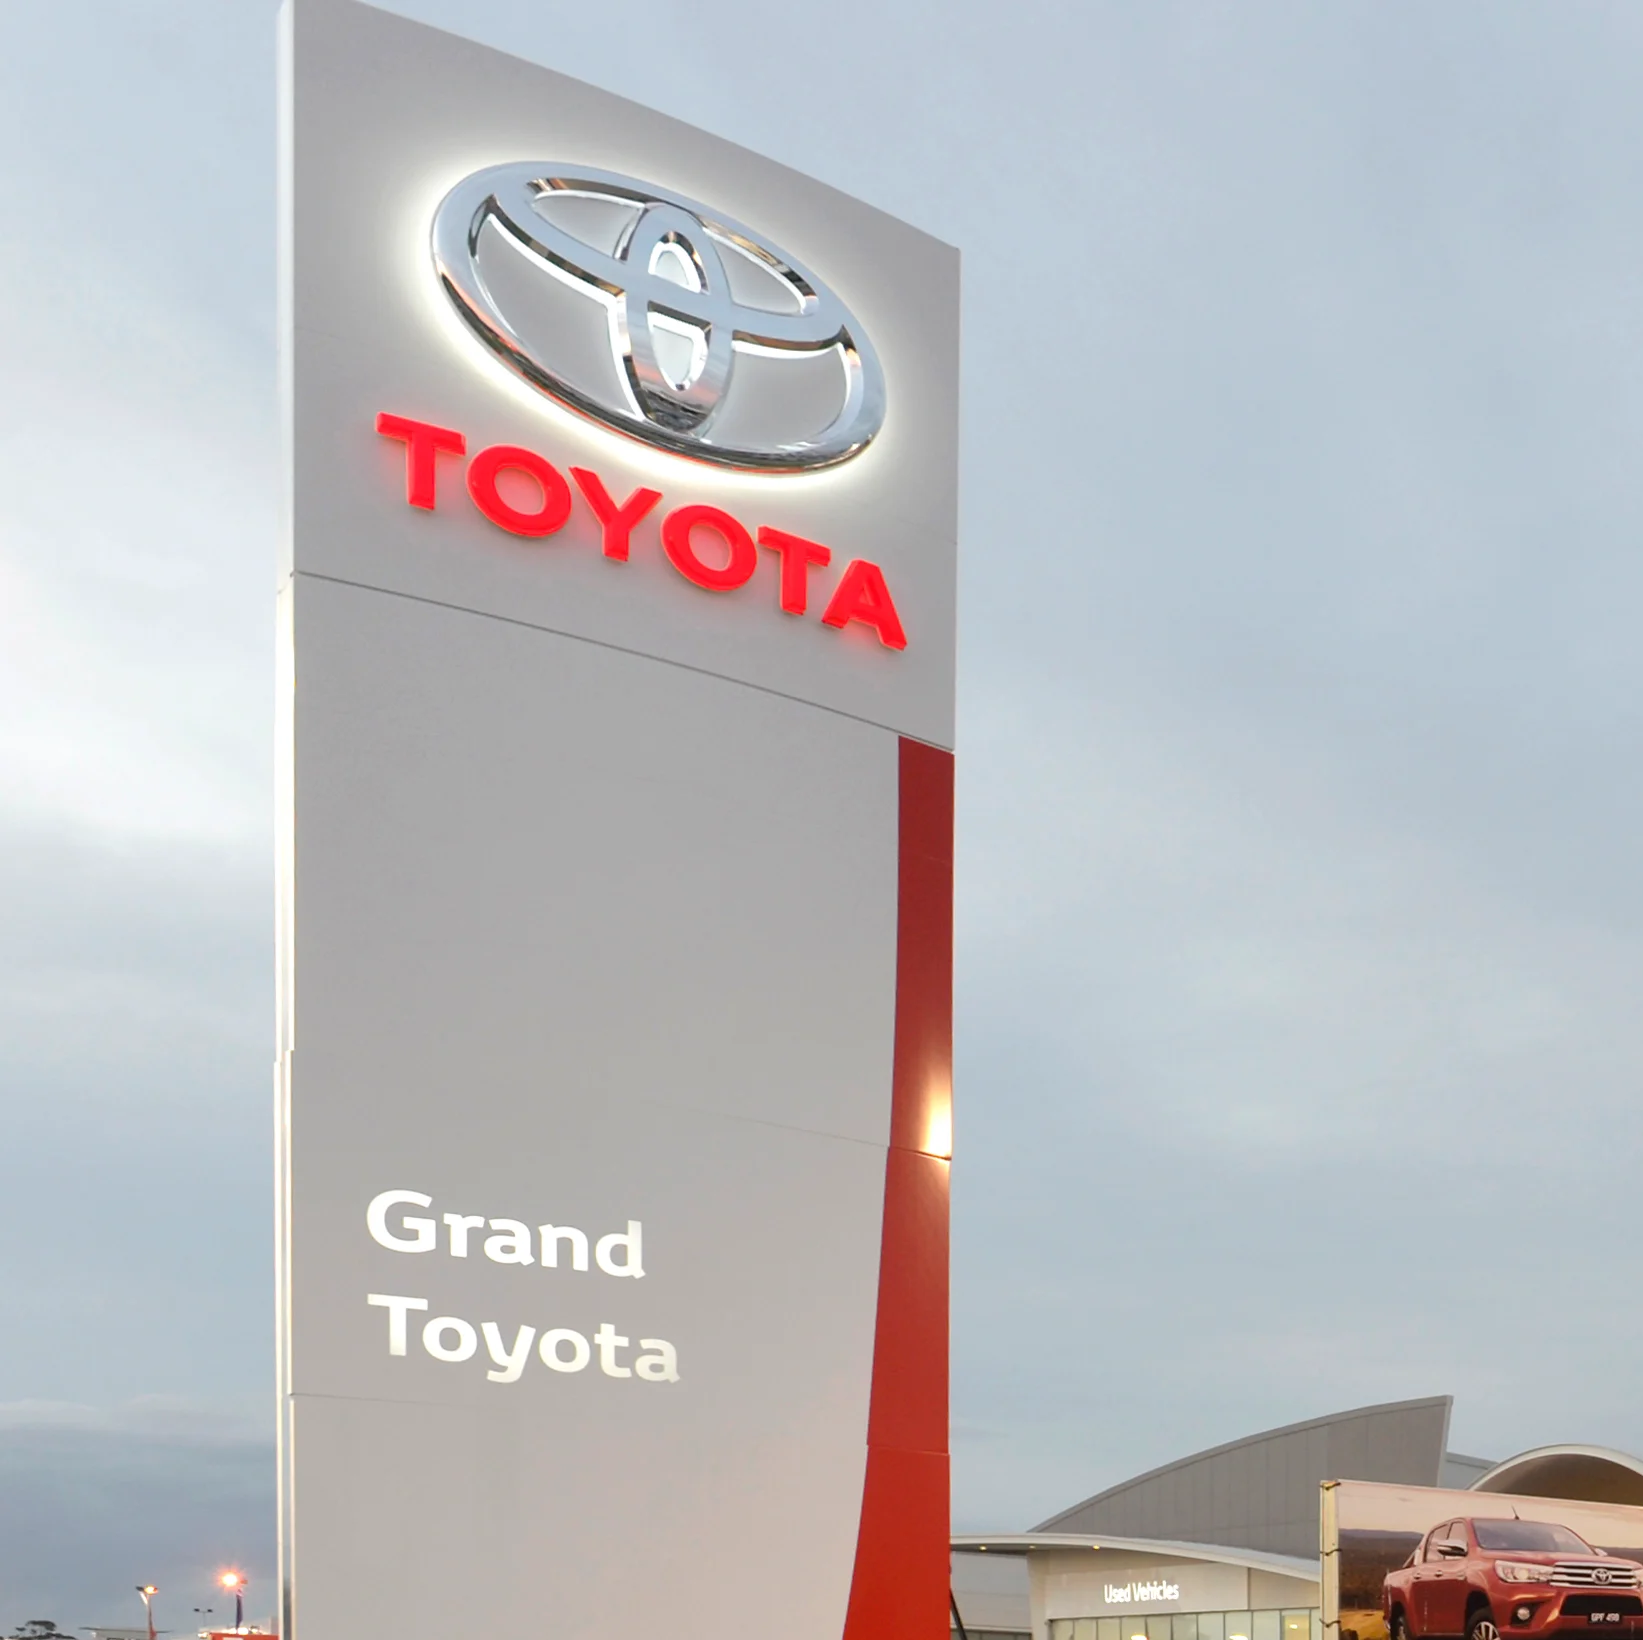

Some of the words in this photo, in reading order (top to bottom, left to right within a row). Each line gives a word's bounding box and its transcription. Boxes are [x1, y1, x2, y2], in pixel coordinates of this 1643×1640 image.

[375, 411, 909, 653] TOYOTA
[366, 1189, 646, 1279] Grand
[367, 1293, 681, 1384] Toyota
[1104, 1583, 1131, 1603] Used
[1132, 1580, 1179, 1602] Vehicles
